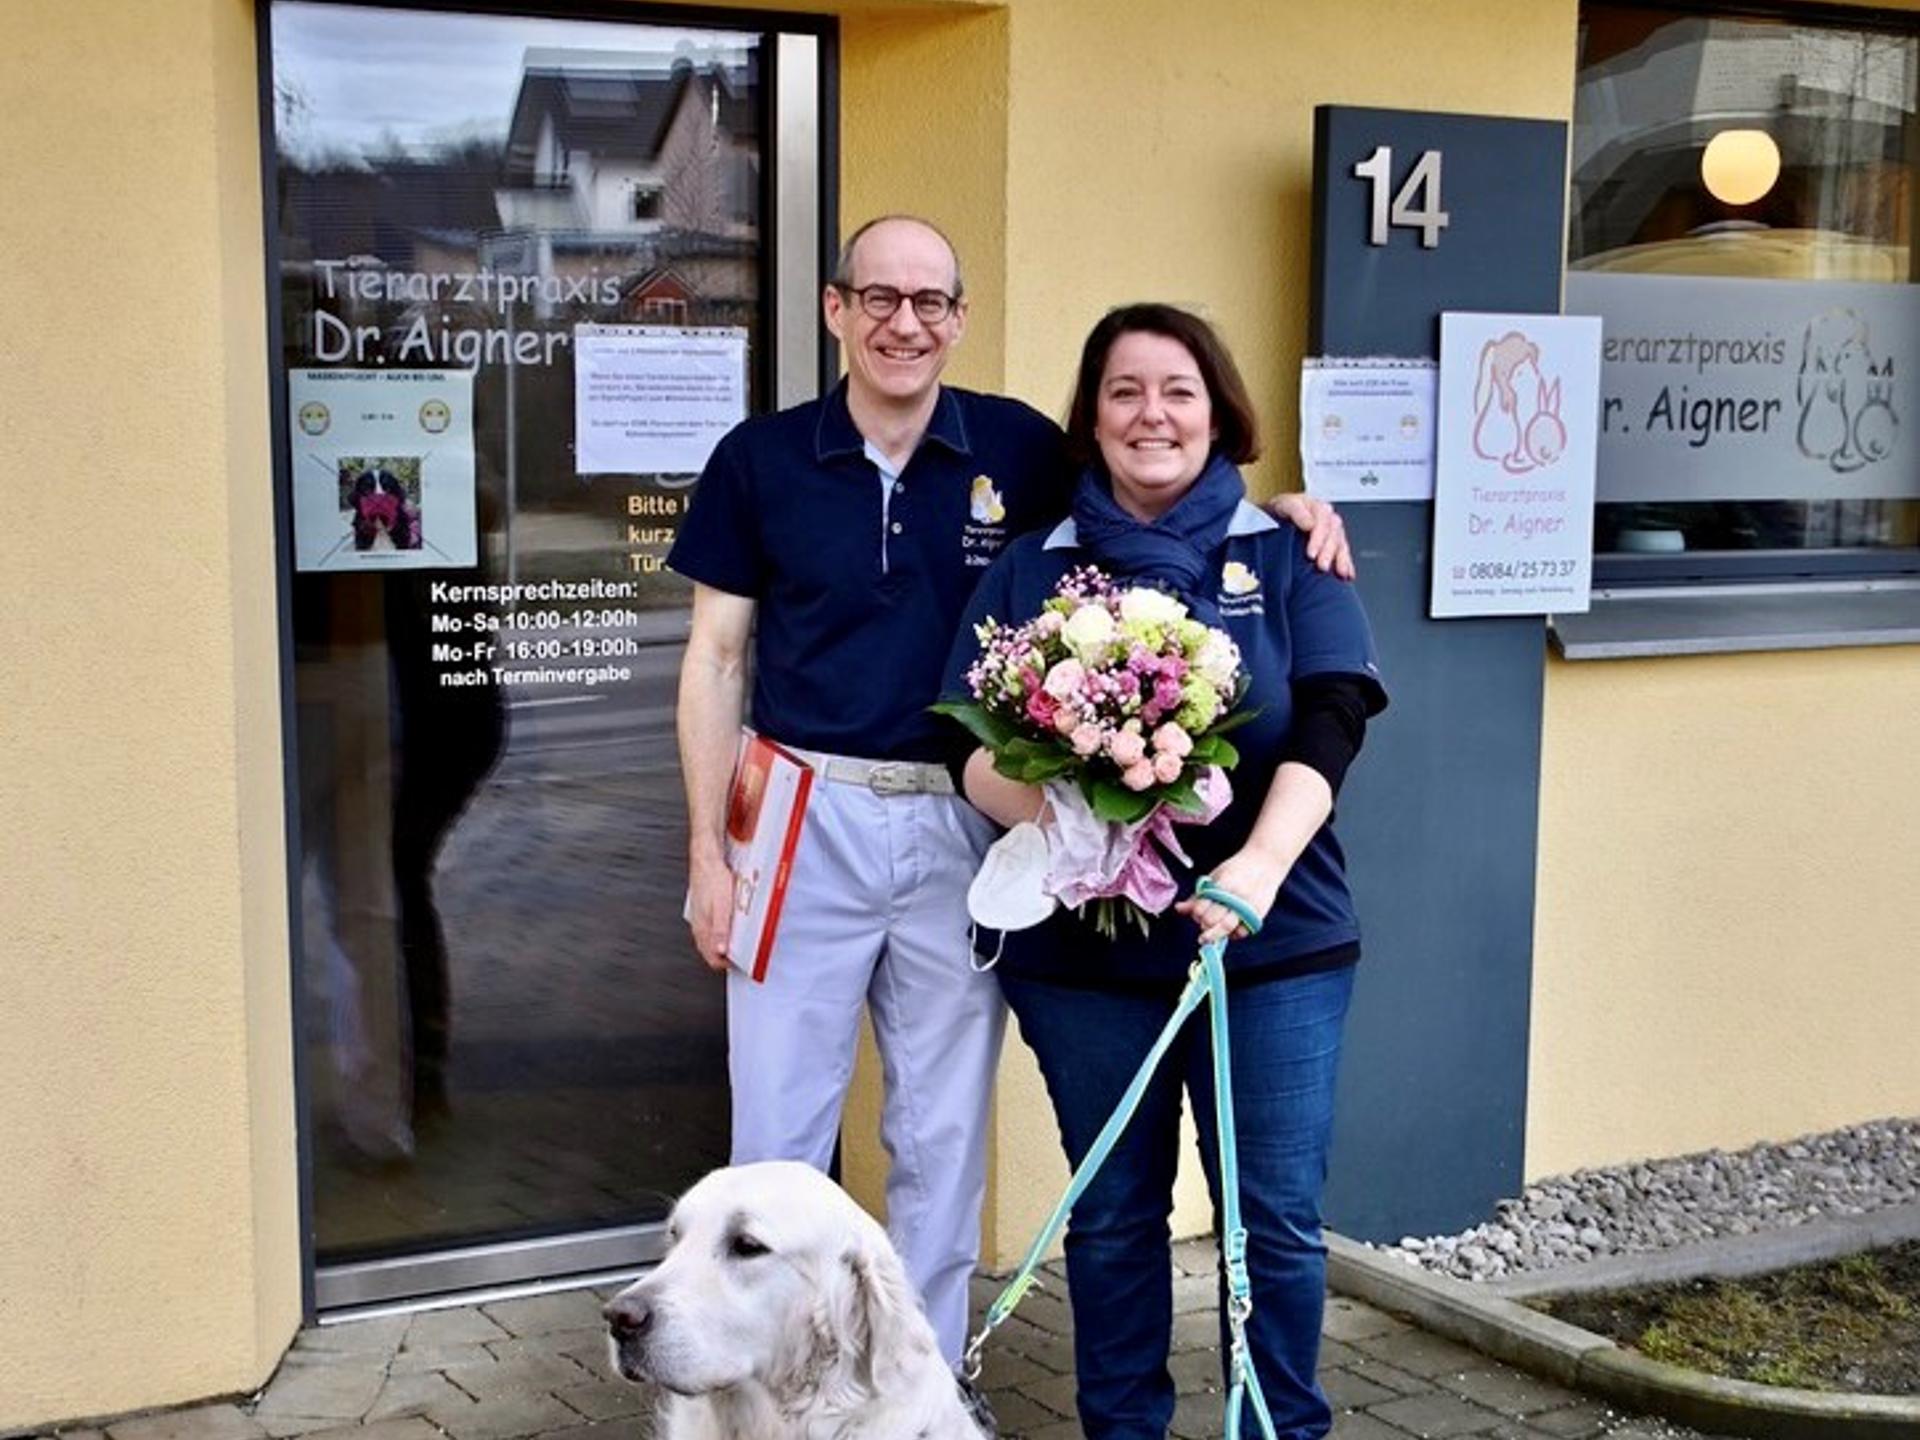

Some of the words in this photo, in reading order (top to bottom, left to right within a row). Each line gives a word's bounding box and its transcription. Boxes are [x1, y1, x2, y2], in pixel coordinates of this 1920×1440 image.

[1354, 145, 1449, 248] 14
[313, 258, 622, 315] Tierarztpraxis
[314, 308, 385, 365] Dr.
[398, 313, 569, 376] Aigner
[1602, 331, 1786, 375] erarztpraxis
[1602, 396, 1630, 433] r.
[1645, 384, 1782, 447] Aigner
[628, 495, 678, 515] Bitte
[1471, 487, 1567, 505] Tierarztpraxis
[628, 525, 675, 544] kurz
[1467, 512, 1497, 534] Dr.
[1503, 513, 1566, 540] Aigner
[430, 580, 638, 605] Kernsprechzeiten:
[431, 612, 500, 633] Mo-Sa
[504, 609, 638, 630] 10:00-12:00h
[431, 643, 497, 662] Mo-Fr
[504, 639, 638, 659] 16:00-19:00h
[440, 669, 488, 686] nach
[492, 665, 631, 685] Terminvergabe
